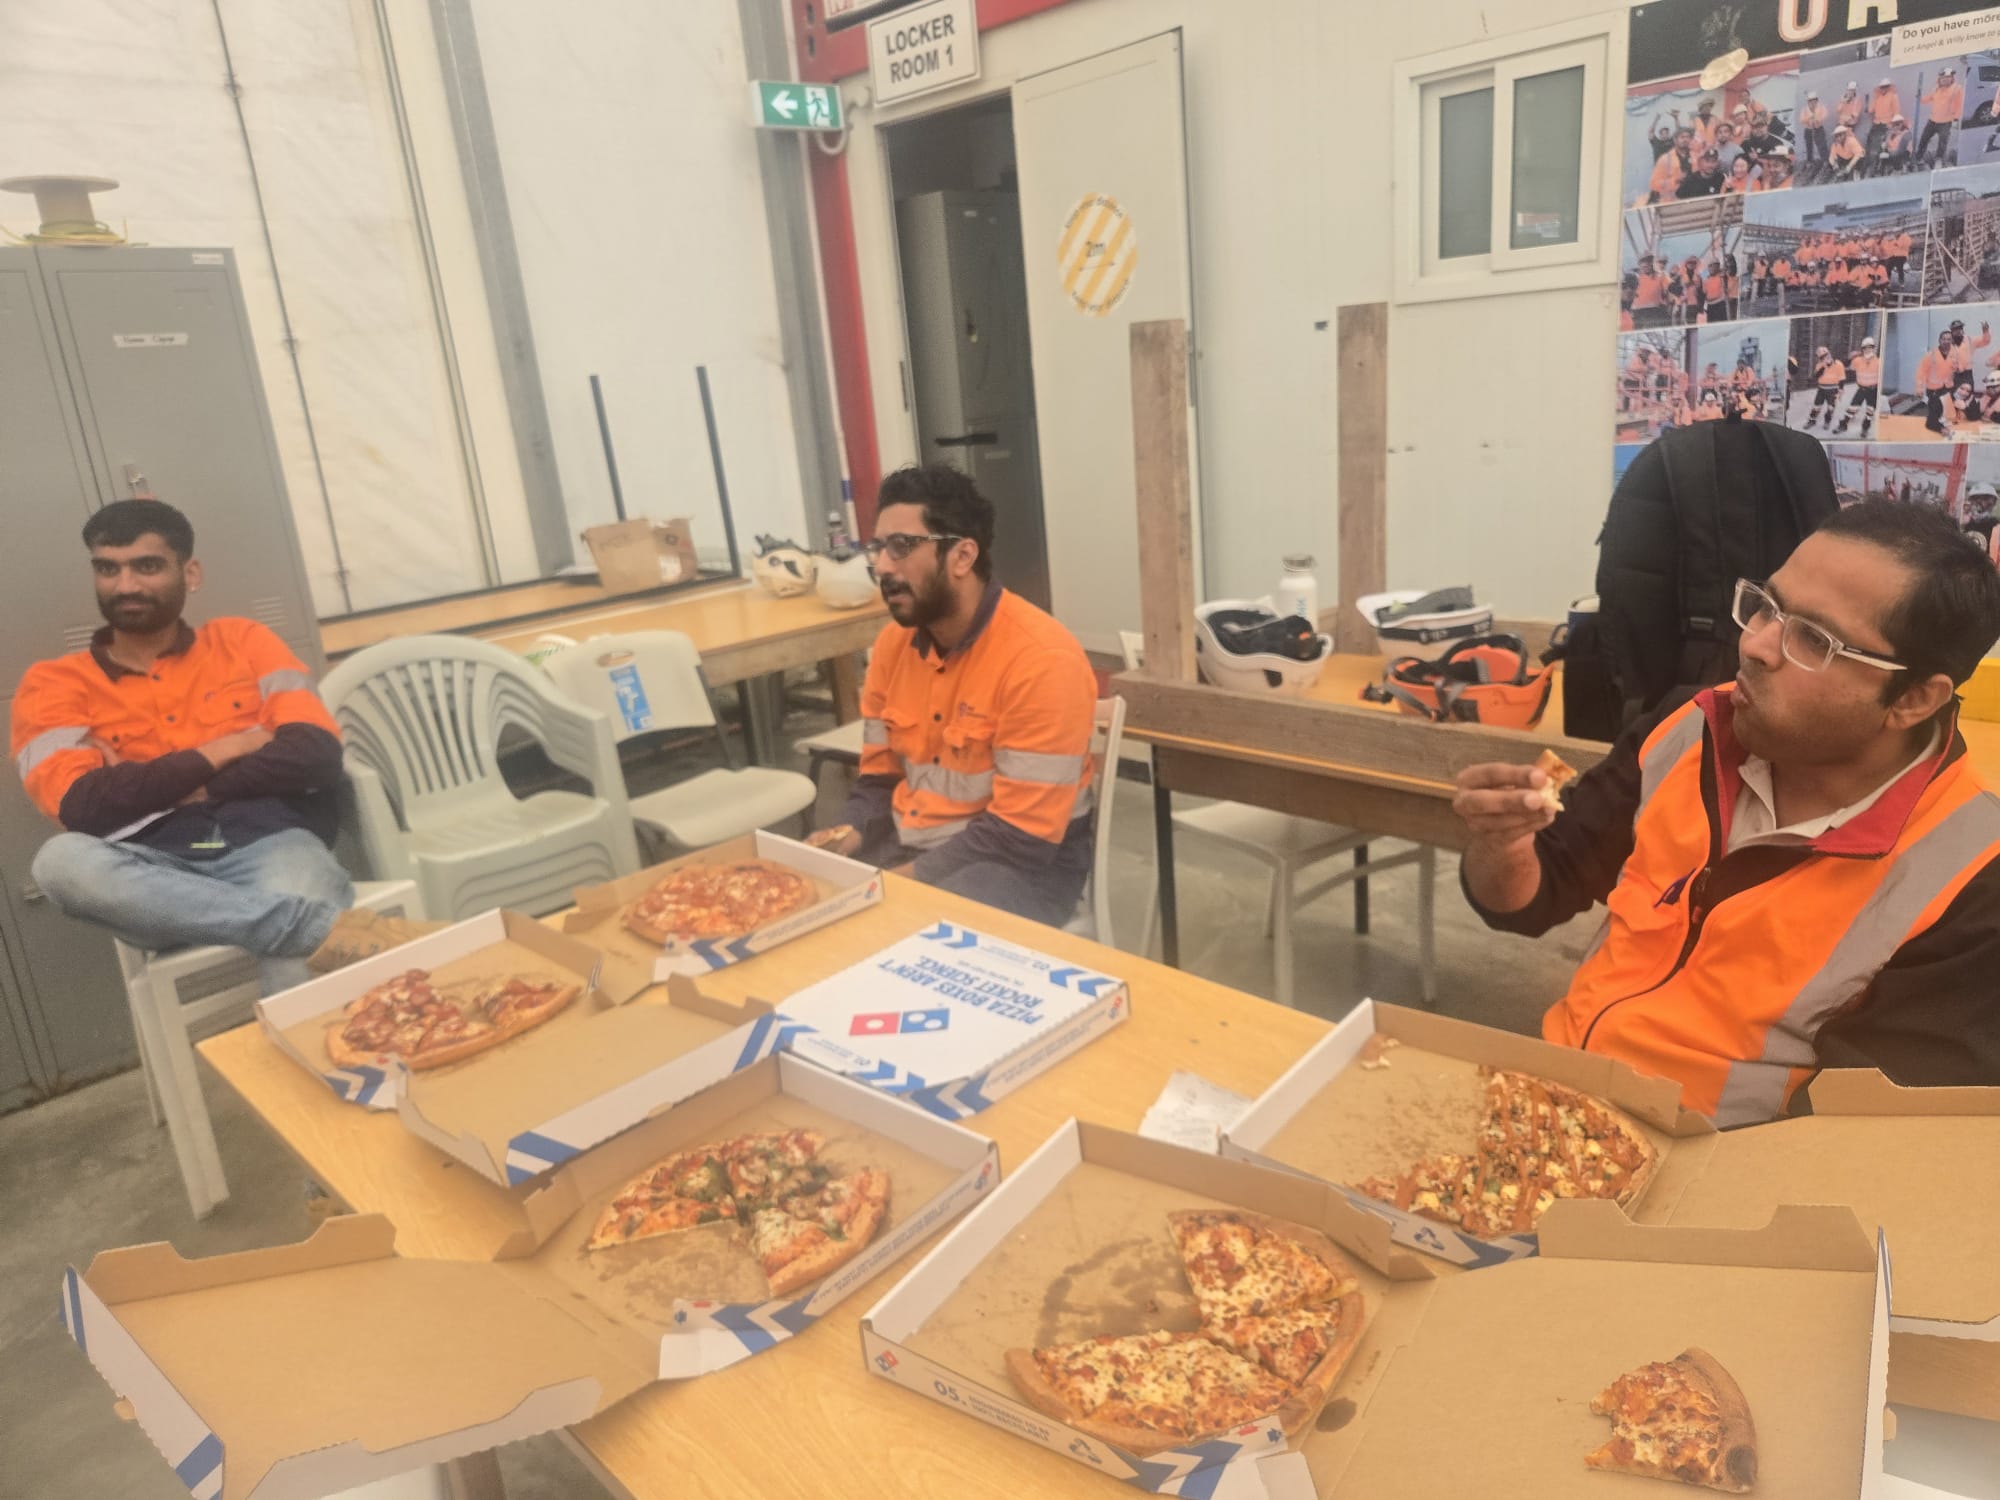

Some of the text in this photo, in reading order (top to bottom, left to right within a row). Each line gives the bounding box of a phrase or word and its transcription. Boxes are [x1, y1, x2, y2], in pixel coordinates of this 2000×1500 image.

[886, 15, 955, 55] LOCKER
[1903, 30, 1917, 39] Do
[1921, 25, 1940, 37] you
[1944, 19, 1969, 31] have
[890, 44, 953, 83] ROOM 1
[878, 959, 938, 986] AREN'T
[934, 981, 989, 1009] BOXES
[980, 981, 1043, 1009] ROCKET
[987, 1000, 1044, 1025] PIZZA
